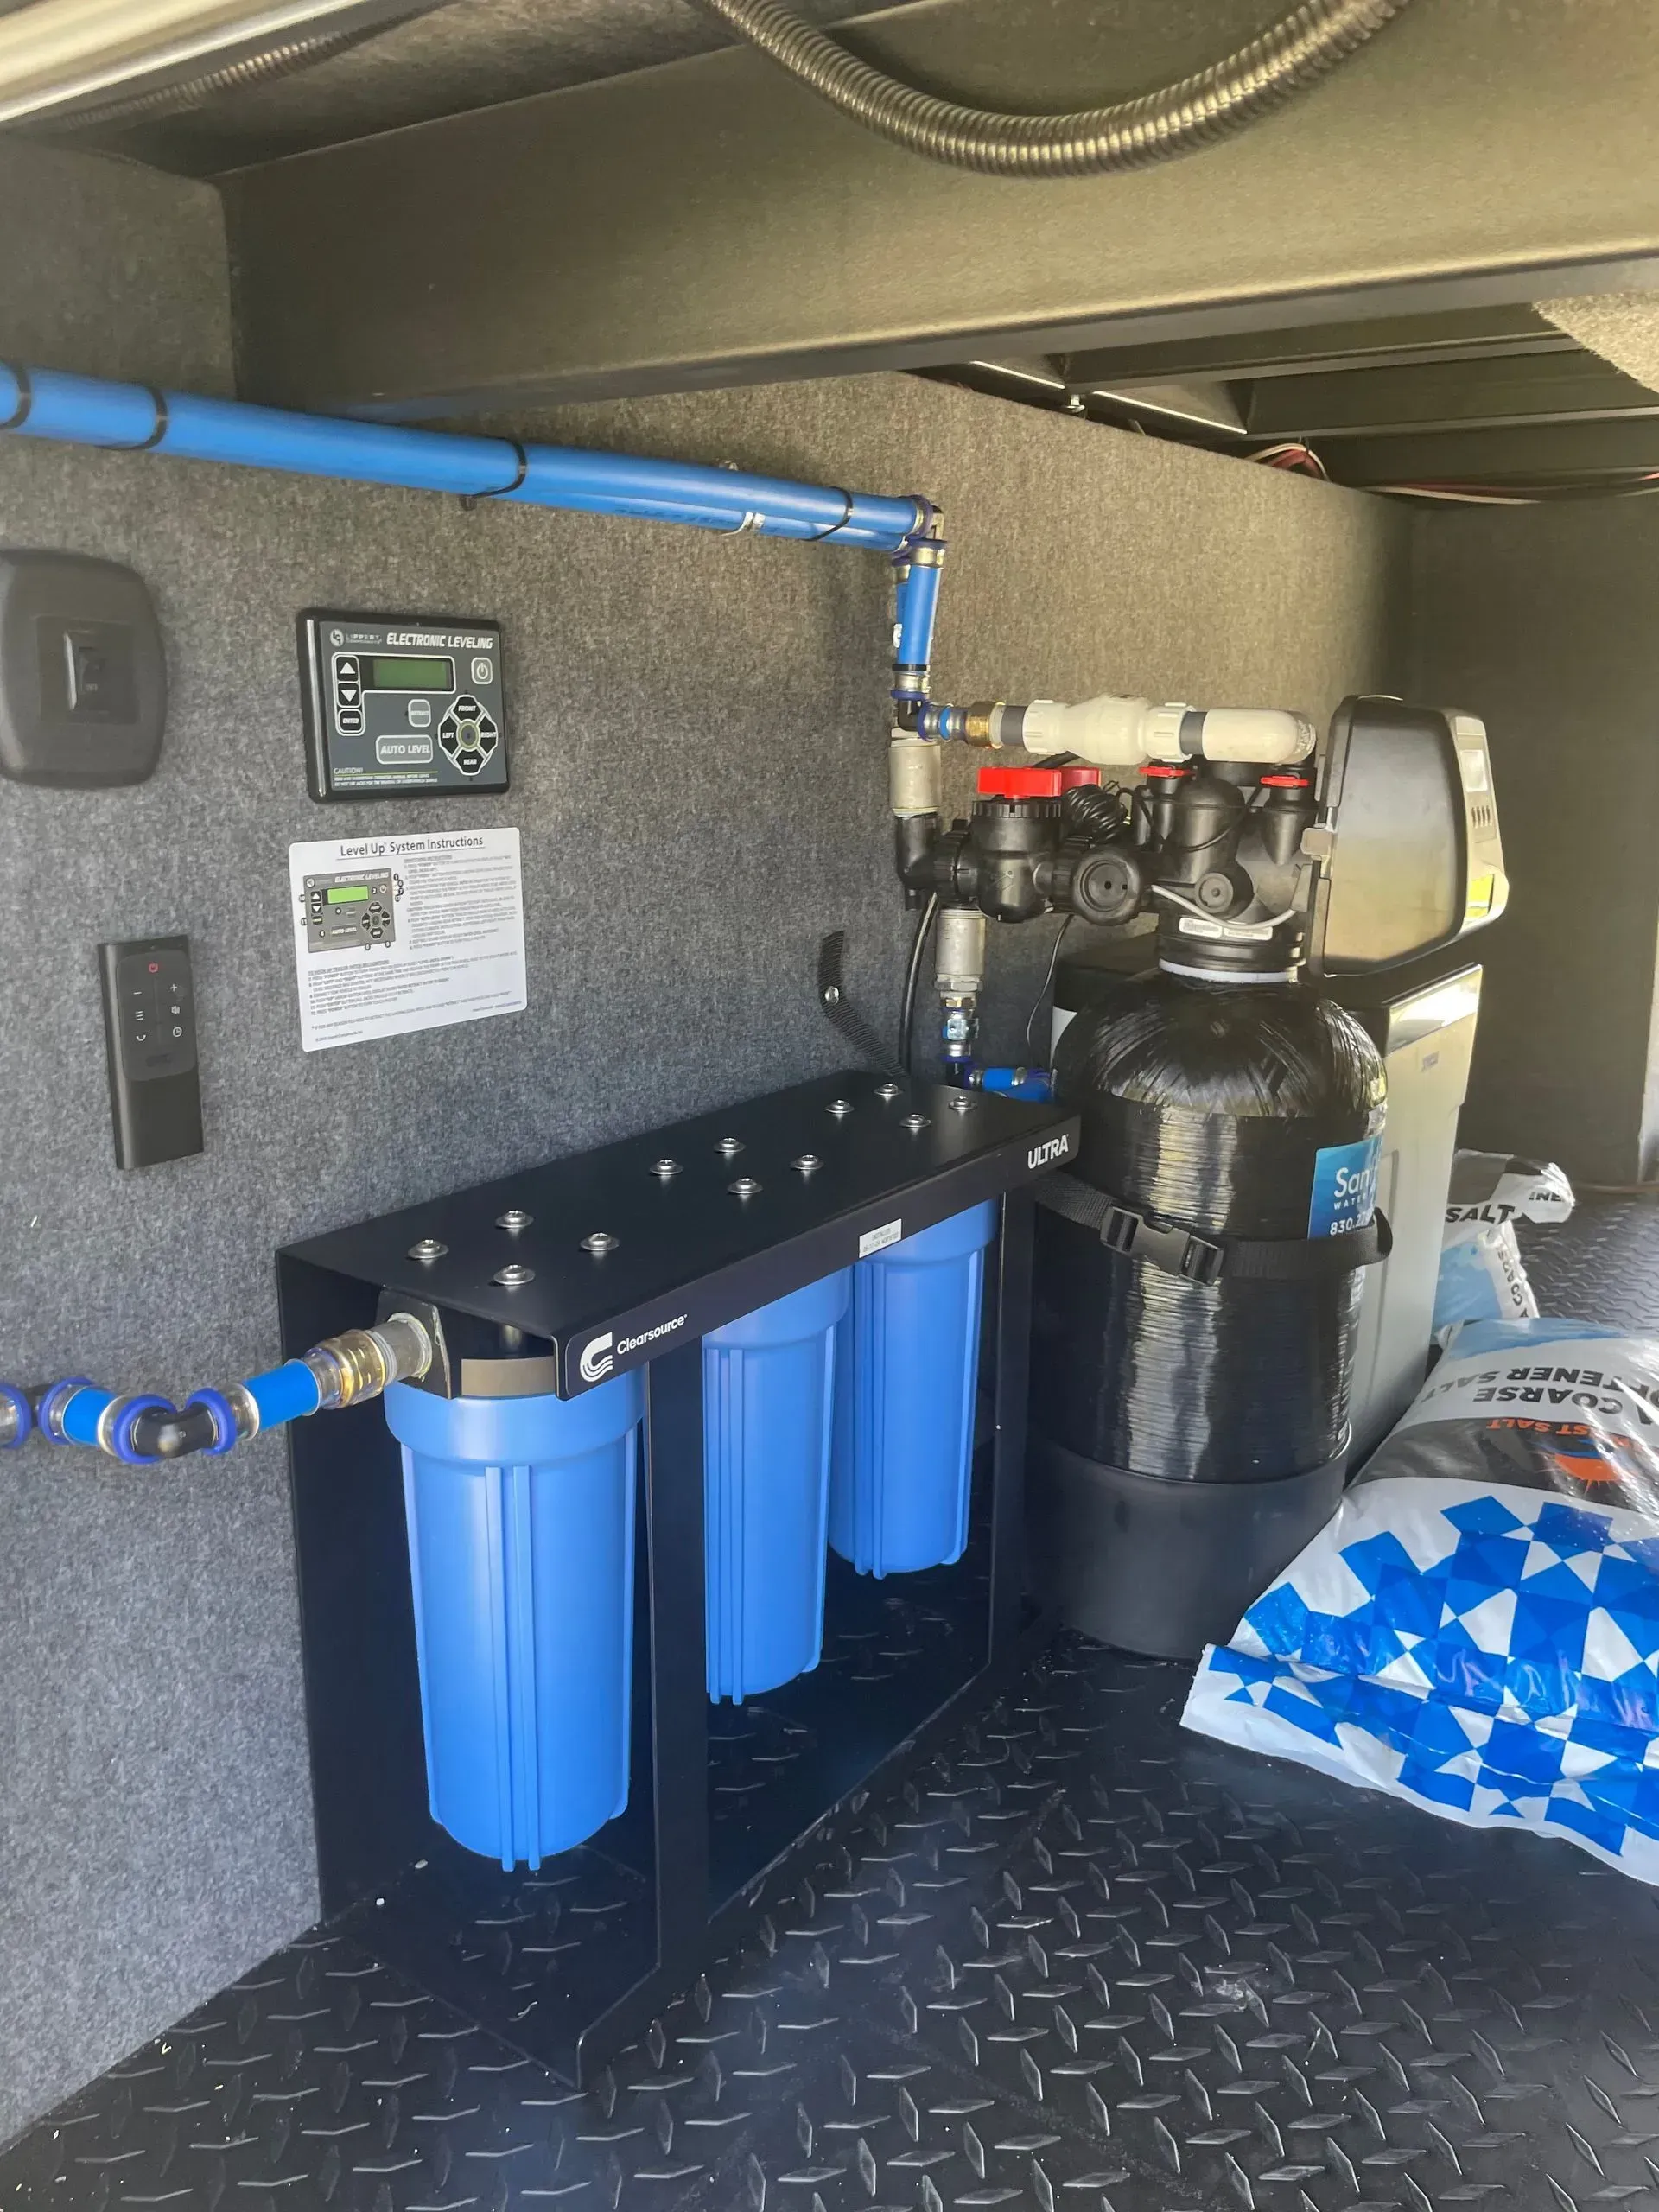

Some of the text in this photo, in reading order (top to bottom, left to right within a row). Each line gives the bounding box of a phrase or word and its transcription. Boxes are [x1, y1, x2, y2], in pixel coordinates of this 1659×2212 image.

[386, 632, 493, 649] ELECTRONIC LEVELING
[380, 745, 430, 755] AUTO LEVEL
[340, 843, 368, 856] Level
[390, 842, 425, 855] System
[427, 836, 483, 849] Instructions
[1028, 1135, 1069, 1169] ULTRA
[1333, 1167, 1375, 1198] San
[1446, 1204, 1516, 1224] SALT
[616, 1313, 687, 1355] Clearsource
[1420, 1370, 1500, 1403] SALT
[1472, 1387, 1623, 1414] COARSE
[1485, 1417, 1549, 1433] SALT
